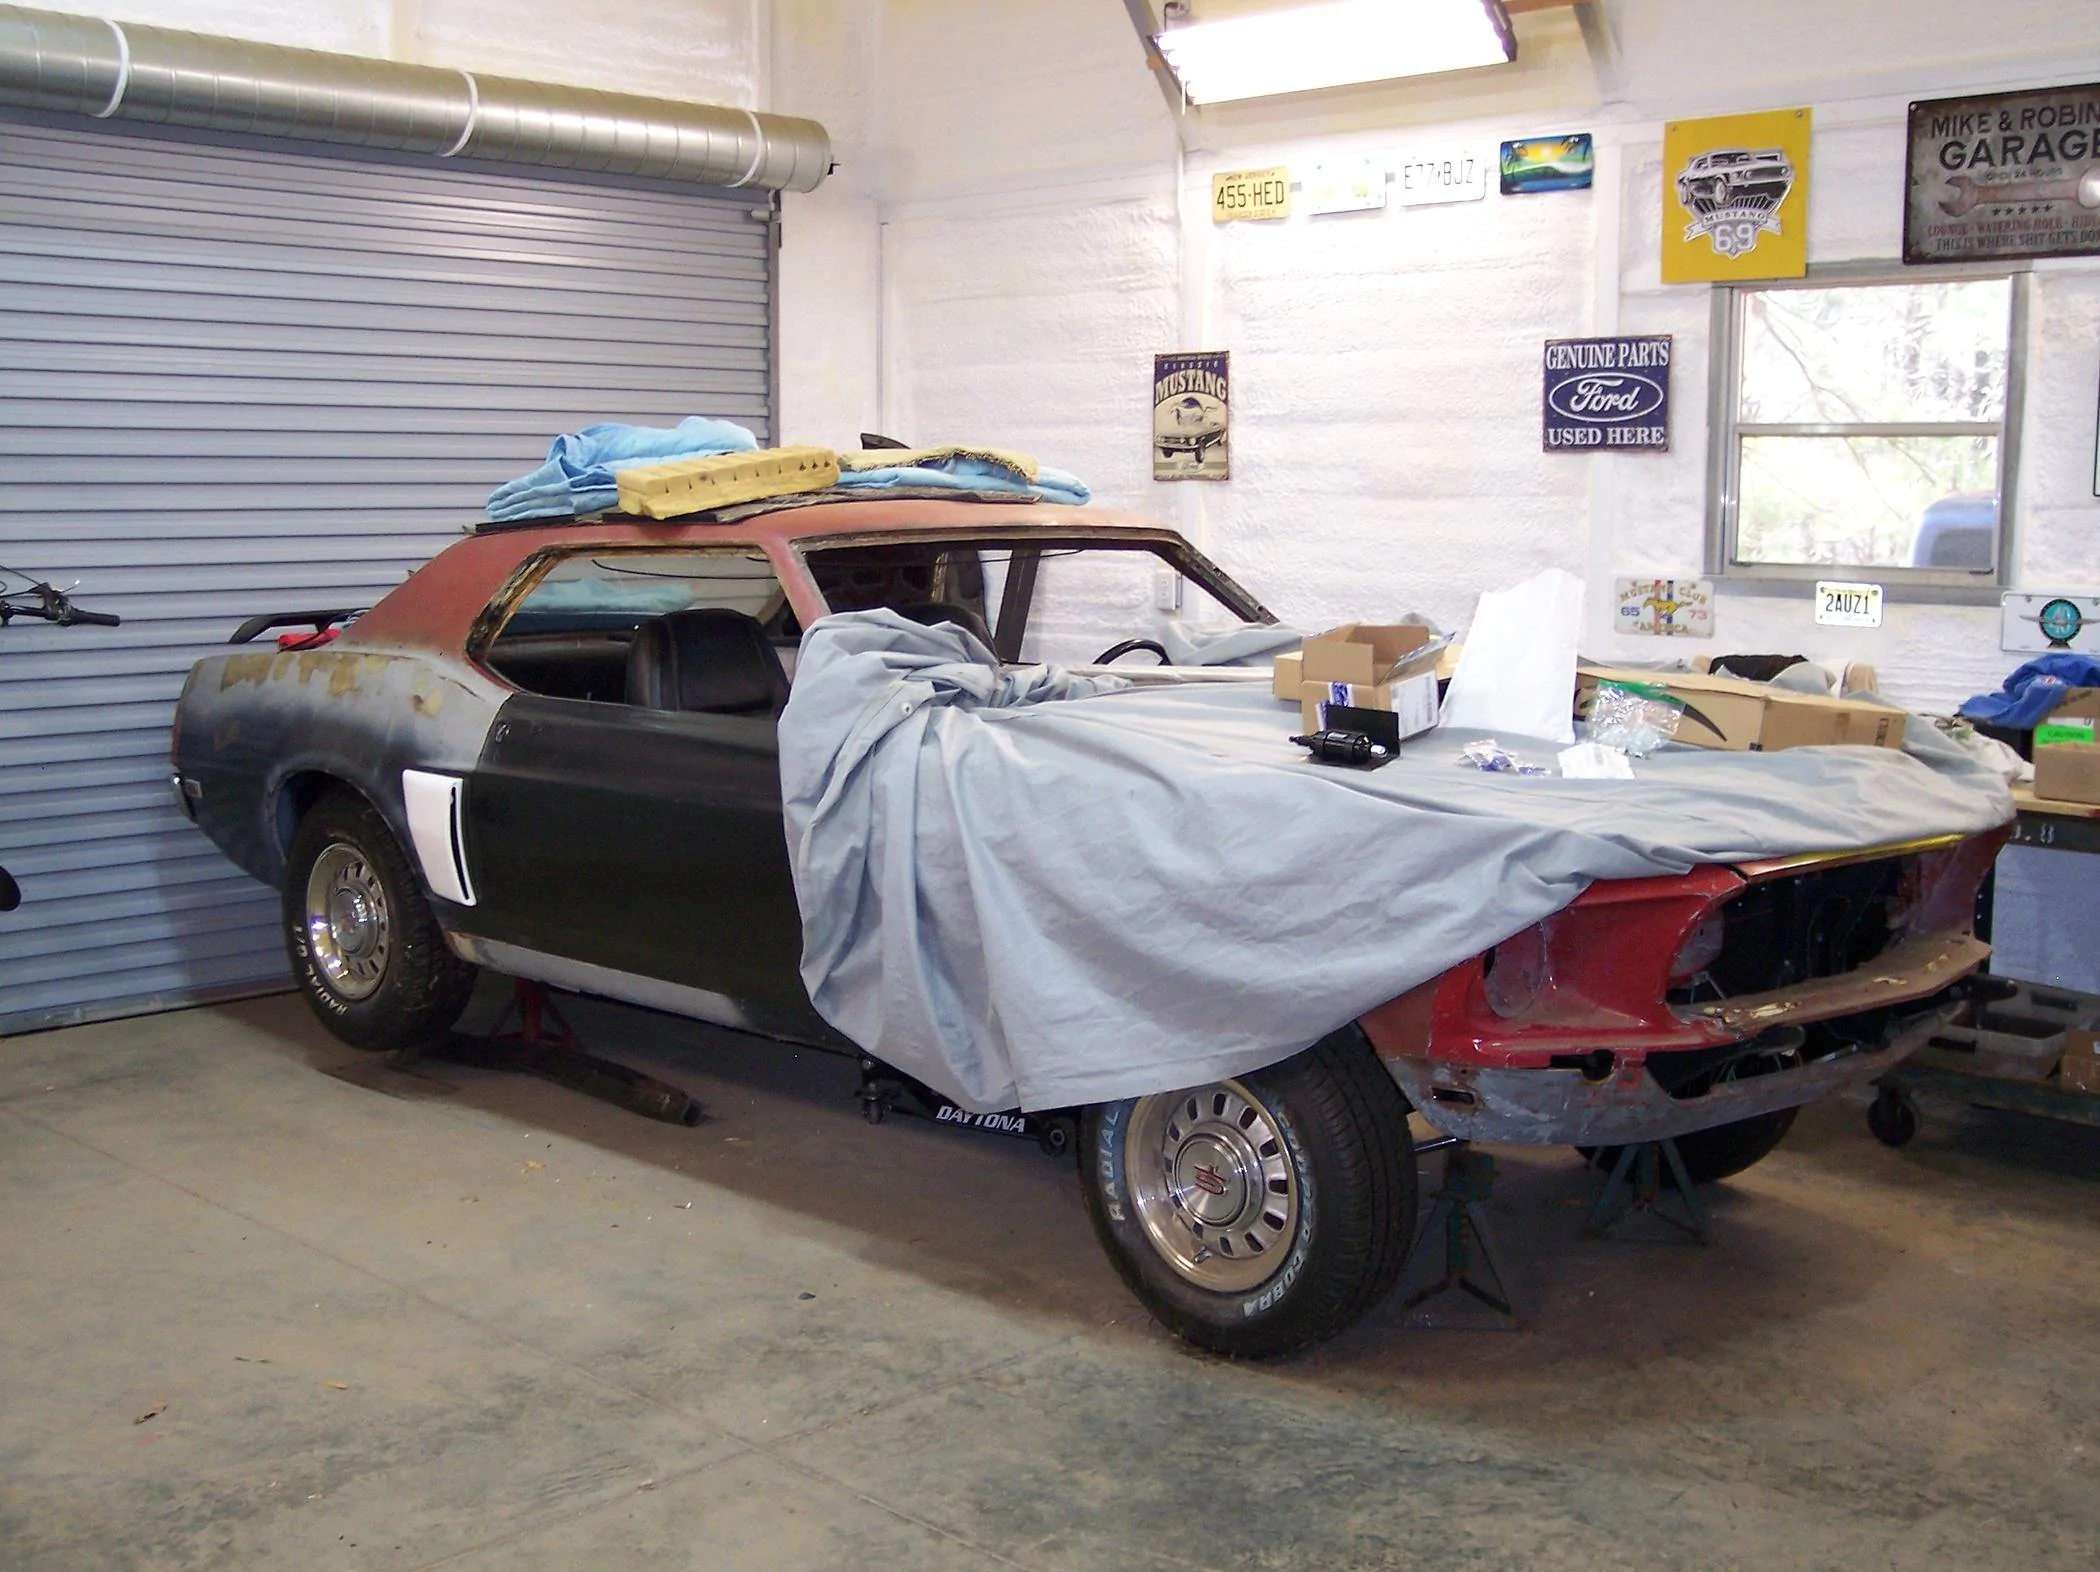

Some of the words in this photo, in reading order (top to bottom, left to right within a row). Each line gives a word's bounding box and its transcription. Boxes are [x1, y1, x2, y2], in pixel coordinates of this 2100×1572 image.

[1931, 112, 1992, 138] MIKE
[1999, 111, 2013, 132] &
[1704, 210, 1765, 221] MUSTANG
[1715, 224, 1754, 251] 69
[1546, 343, 1616, 370] GENUINE
[1618, 341, 1670, 367] PARTS
[1155, 368, 1228, 405] MUSTANG
[1570, 378, 1642, 412] Ford
[1547, 427, 1602, 446] USED
[1606, 426, 1665, 445] HERE
[1620, 606, 1641, 617] 65
[1687, 608, 1708, 621] 73
[1825, 593, 1870, 614] 2AUZ1
[1100, 1110, 1126, 1221] RADIAL
